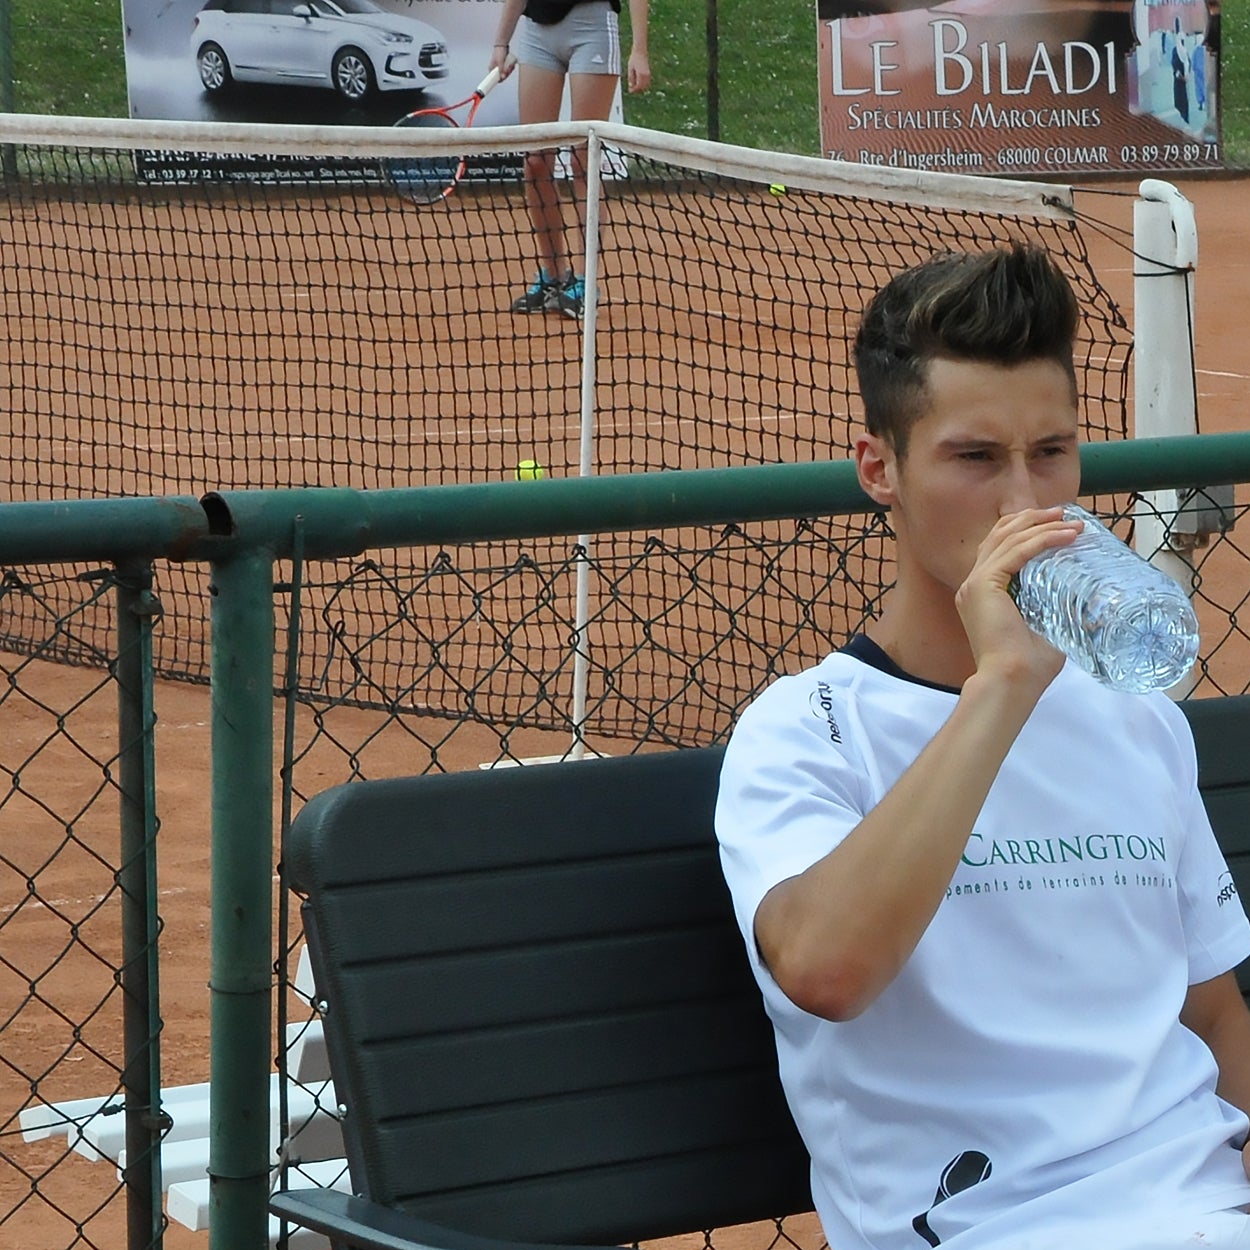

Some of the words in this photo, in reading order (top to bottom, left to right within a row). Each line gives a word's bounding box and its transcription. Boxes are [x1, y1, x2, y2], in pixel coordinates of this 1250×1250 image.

[826, 18, 902, 97] LE
[928, 18, 1118, 97] BILADI
[848, 103, 963, 130] SPÉCIALITÉS
[970, 103, 1101, 129] MAROCAINES
[997, 148, 1040, 166] 68000
[1044, 146, 1109, 164] COLMAR
[1121, 146, 1137, 163] 03
[1142, 145, 1158, 162] 89
[1163, 145, 1179, 162] 79
[1183, 145, 1199, 161] 89
[1204, 144, 1219, 161] 71
[961, 833, 1167, 866] CARRINGTON
[1019, 875, 1032, 890] de
[1043, 873, 1105, 890] terrains
[1114, 870, 1127, 885] de
